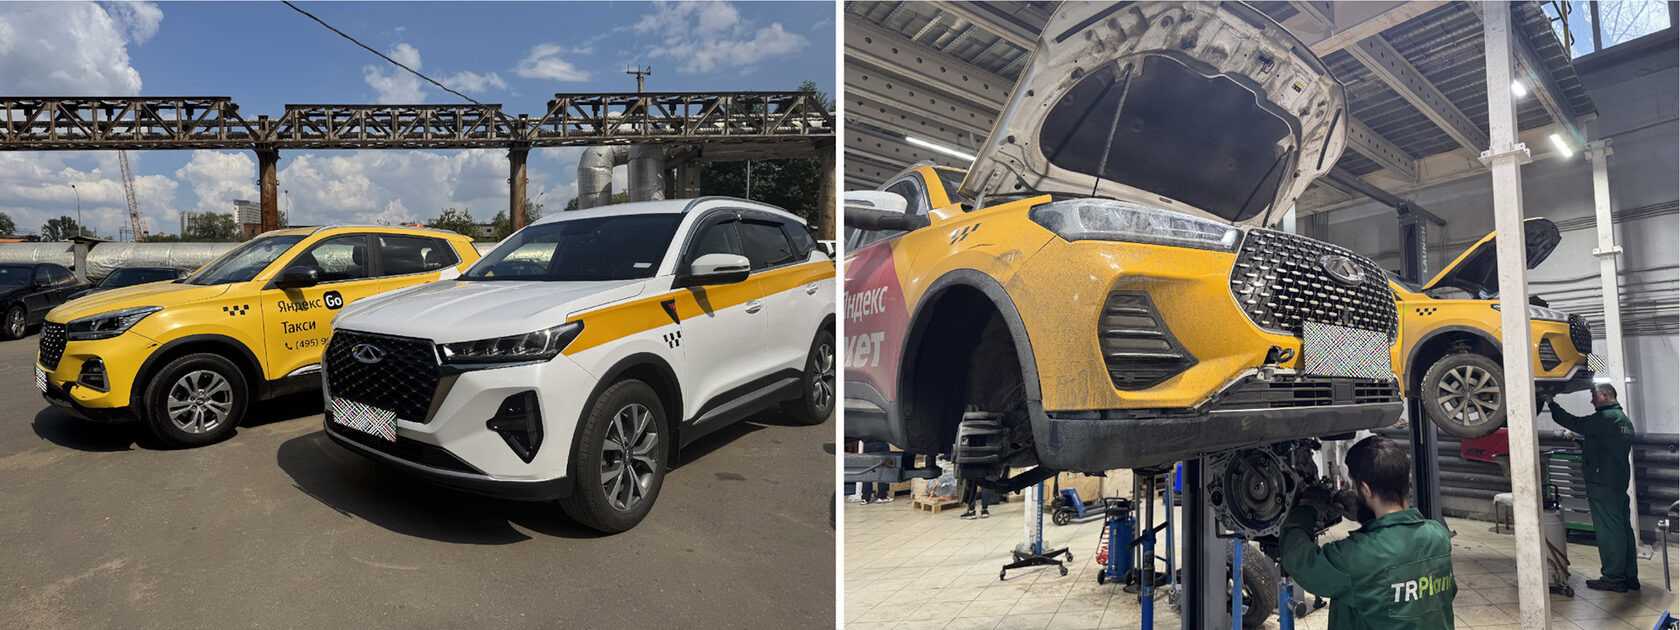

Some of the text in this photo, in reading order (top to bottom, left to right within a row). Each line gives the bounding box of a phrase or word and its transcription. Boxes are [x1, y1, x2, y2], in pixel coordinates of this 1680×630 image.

[277, 294, 342, 313] Яндекс Go
[280, 320, 316, 334] Такси
[295, 338, 319, 350] (495)
